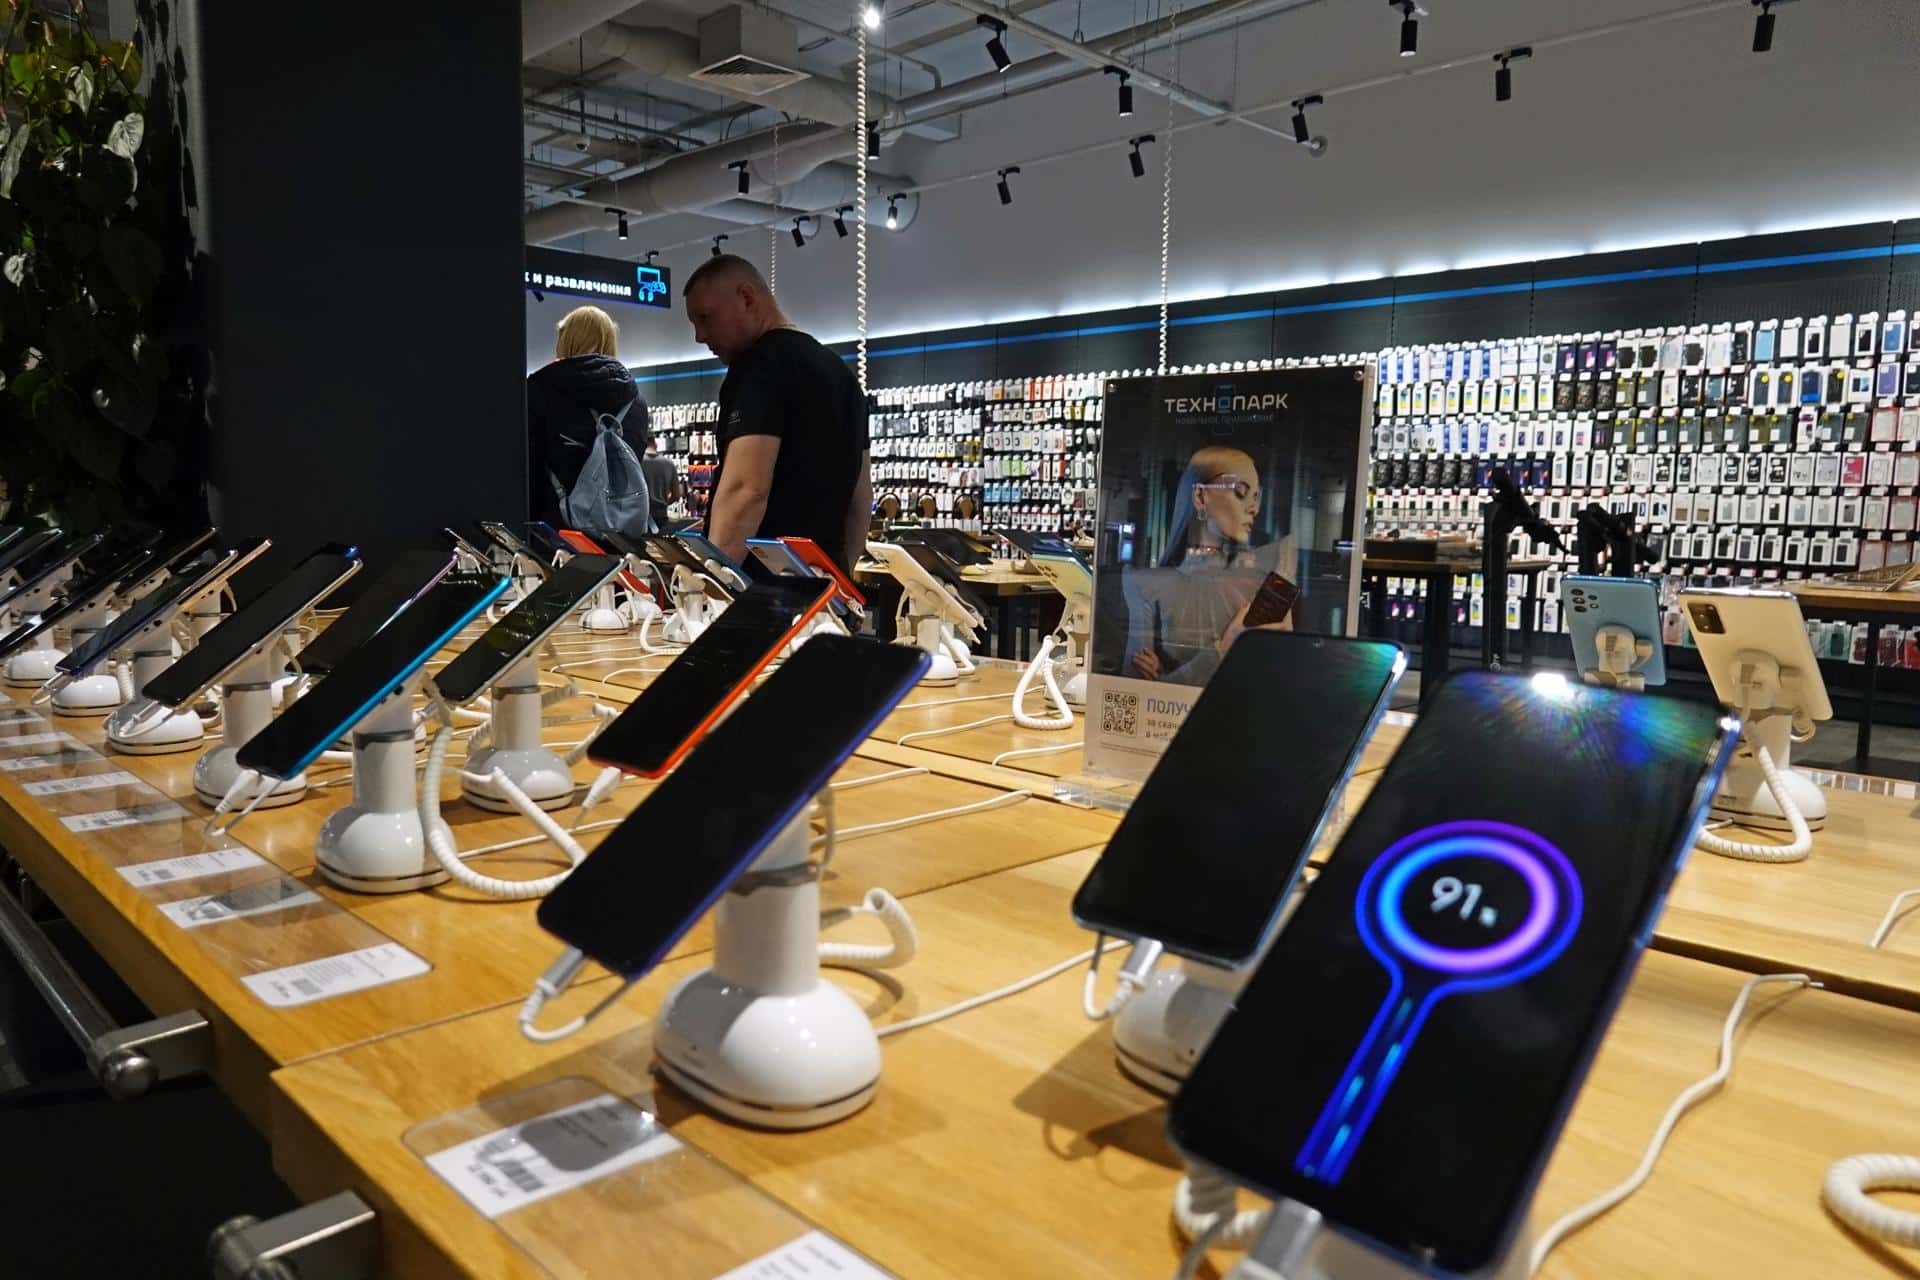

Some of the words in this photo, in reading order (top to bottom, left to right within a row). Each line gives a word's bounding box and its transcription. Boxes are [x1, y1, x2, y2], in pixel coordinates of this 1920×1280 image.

[533, 273, 543, 285] и
[545, 274, 632, 297] развлечения
[1164, 393, 1288, 413] ТЕХНОПАРК
